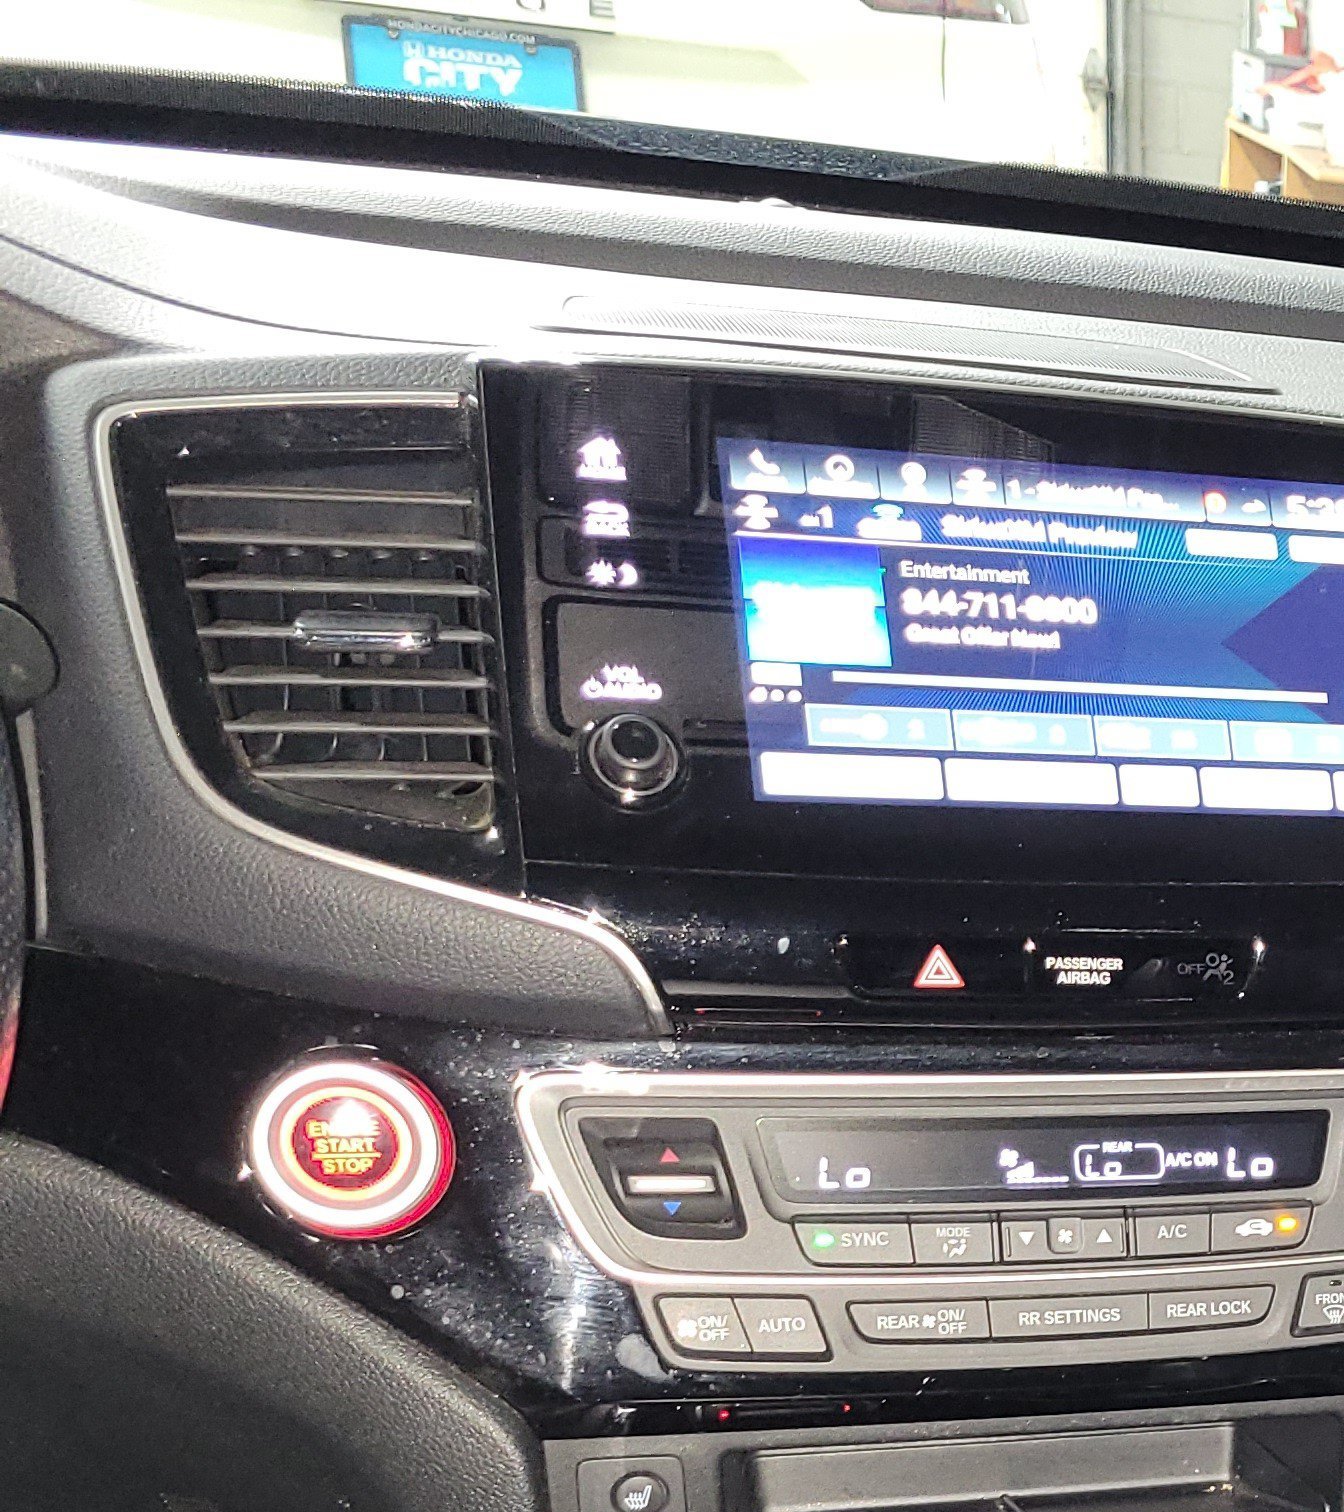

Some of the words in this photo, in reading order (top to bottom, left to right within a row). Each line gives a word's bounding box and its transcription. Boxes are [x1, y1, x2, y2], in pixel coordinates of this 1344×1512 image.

[426, 46, 522, 69] HONDA
[402, 56, 523, 97] CITY
[900, 559, 1031, 585] Entertainment
[1046, 956, 1123, 971] PASSENGER
[1177, 962, 1205, 976] OFF
[1057, 970, 1111, 985] AIRBAG
[315, 1137, 376, 1154] START
[1102, 1141, 1133, 1153] REAR
[323, 1158, 374, 1175] STOP
[1166, 1151, 1193, 1168] A/C
[1194, 1150, 1218, 1168] ON
[840, 1231, 890, 1248] SYNC
[936, 1226, 972, 1239] MODE
[1157, 1223, 1188, 1240] A/C
[1018, 1311, 1040, 1326] RR
[1044, 1307, 1121, 1325] SETTINGS
[1166, 1302, 1206, 1319] REAR
[1209, 1299, 1252, 1316] LOCK
[698, 1314, 728, 1328] ON/
[758, 1316, 806, 1333] AUTO
[876, 1314, 919, 1331] REAR
[936, 1309, 966, 1324] ON/
[938, 1321, 968, 1336] OFF
[699, 1327, 730, 1342] OFF
